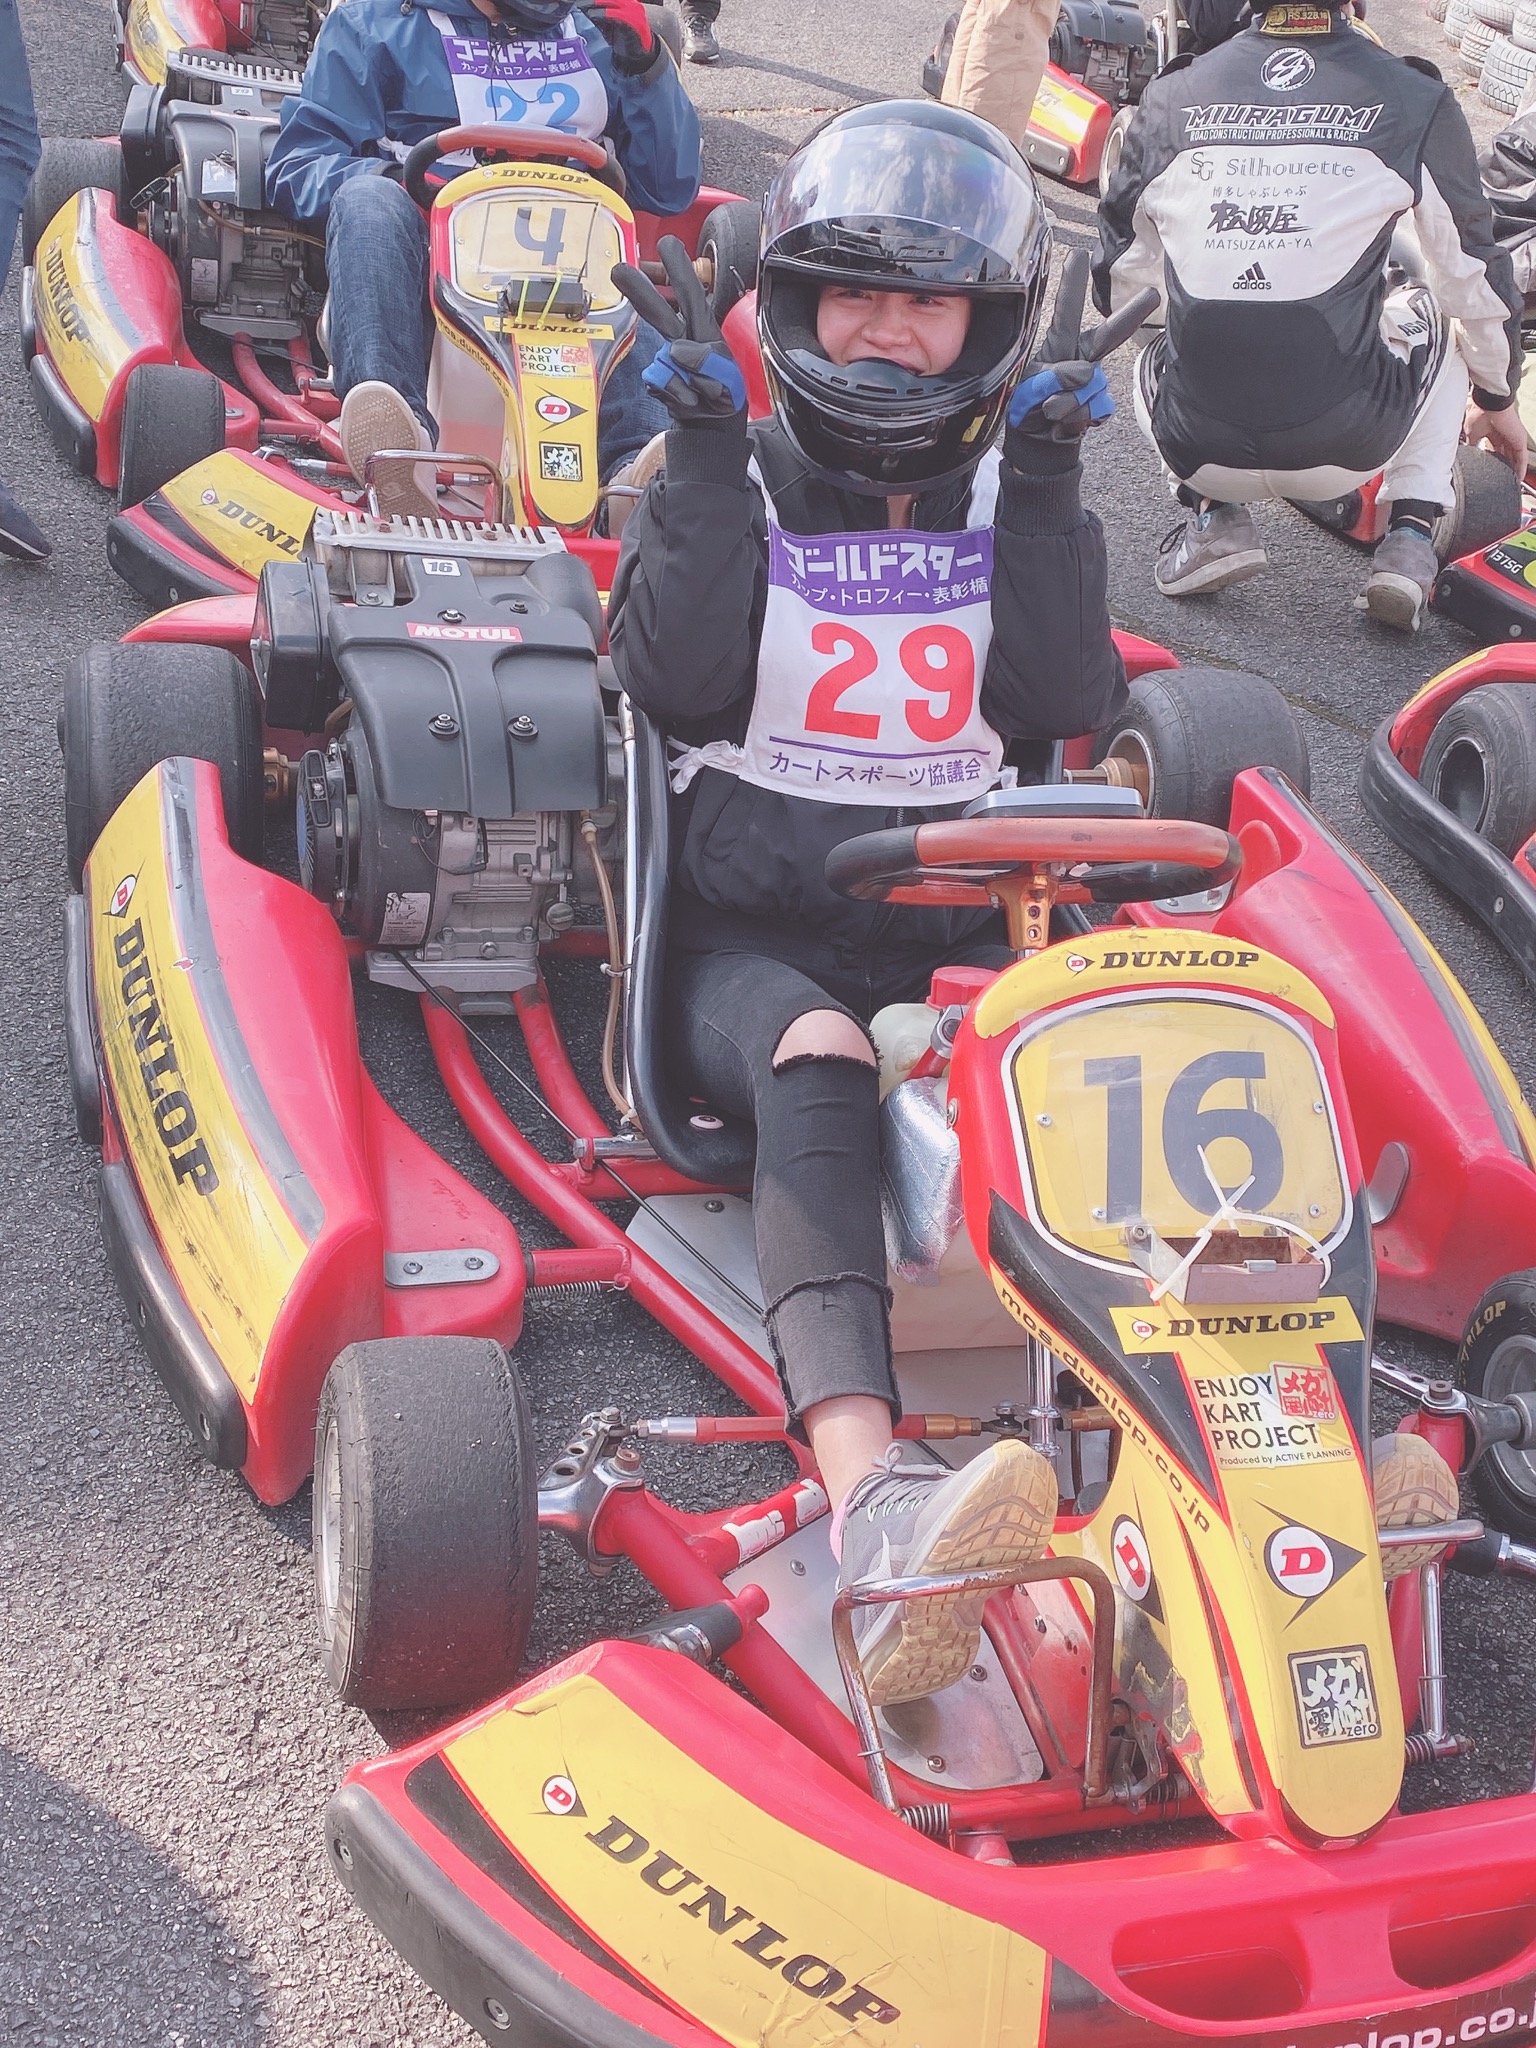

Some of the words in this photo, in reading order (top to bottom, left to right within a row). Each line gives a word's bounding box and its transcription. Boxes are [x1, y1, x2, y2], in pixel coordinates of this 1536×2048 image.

[485, 83, 580, 135] 22
[1181, 103, 1385, 133] MIURAGUMI
[1190, 128, 1208, 142] ROAD
[1209, 128, 1266, 141] CONSTRUCTION
[1267, 128, 1325, 141] PROFESSIONAL
[1333, 130, 1359, 142] RACER
[500, 169, 589, 185] DUNLOP
[1226, 157, 1356, 178] Silhouette
[514, 207, 566, 265] 4
[1204, 238, 1312, 250] MATSUZAKA-YA
[46, 248, 91, 342] DUNLOP
[1233, 280, 1272, 290] adidas
[510, 322, 603, 334] DUNLOP
[519, 345, 560, 355] ENJOY
[519, 353, 550, 363] KART
[521, 362, 577, 373] PROJECT
[428, 561, 453, 573] 16
[781, 537, 983, 582] ゴールドスター
[414, 625, 516, 640] MOTUL
[804, 622, 975, 743] 29
[769, 752, 981, 787] カートスポーツ協議会
[1100, 950, 1259, 969] DUNLOP
[113, 917, 220, 1196] DUNLOP
[1084, 1051, 1284, 1225] 16
[1167, 1311, 1335, 1337] DUNLOP
[1193, 1375, 1273, 1398] ENJOY
[1001, 1288, 1211, 1534] mos.dunlop.co.jp
[1203, 1401, 1263, 1424] KART
[1212, 1424, 1319, 1450] PROJECT
[1219, 1456, 1260, 1465] Produced
[1262, 1456, 1273, 1464] by
[1275, 1452, 1305, 1461] ACTIVE
[1307, 1449, 1352, 1459] PLANNING
[1347, 1723, 1377, 1737] zero
[584, 1815, 902, 2025] DUNLOP
